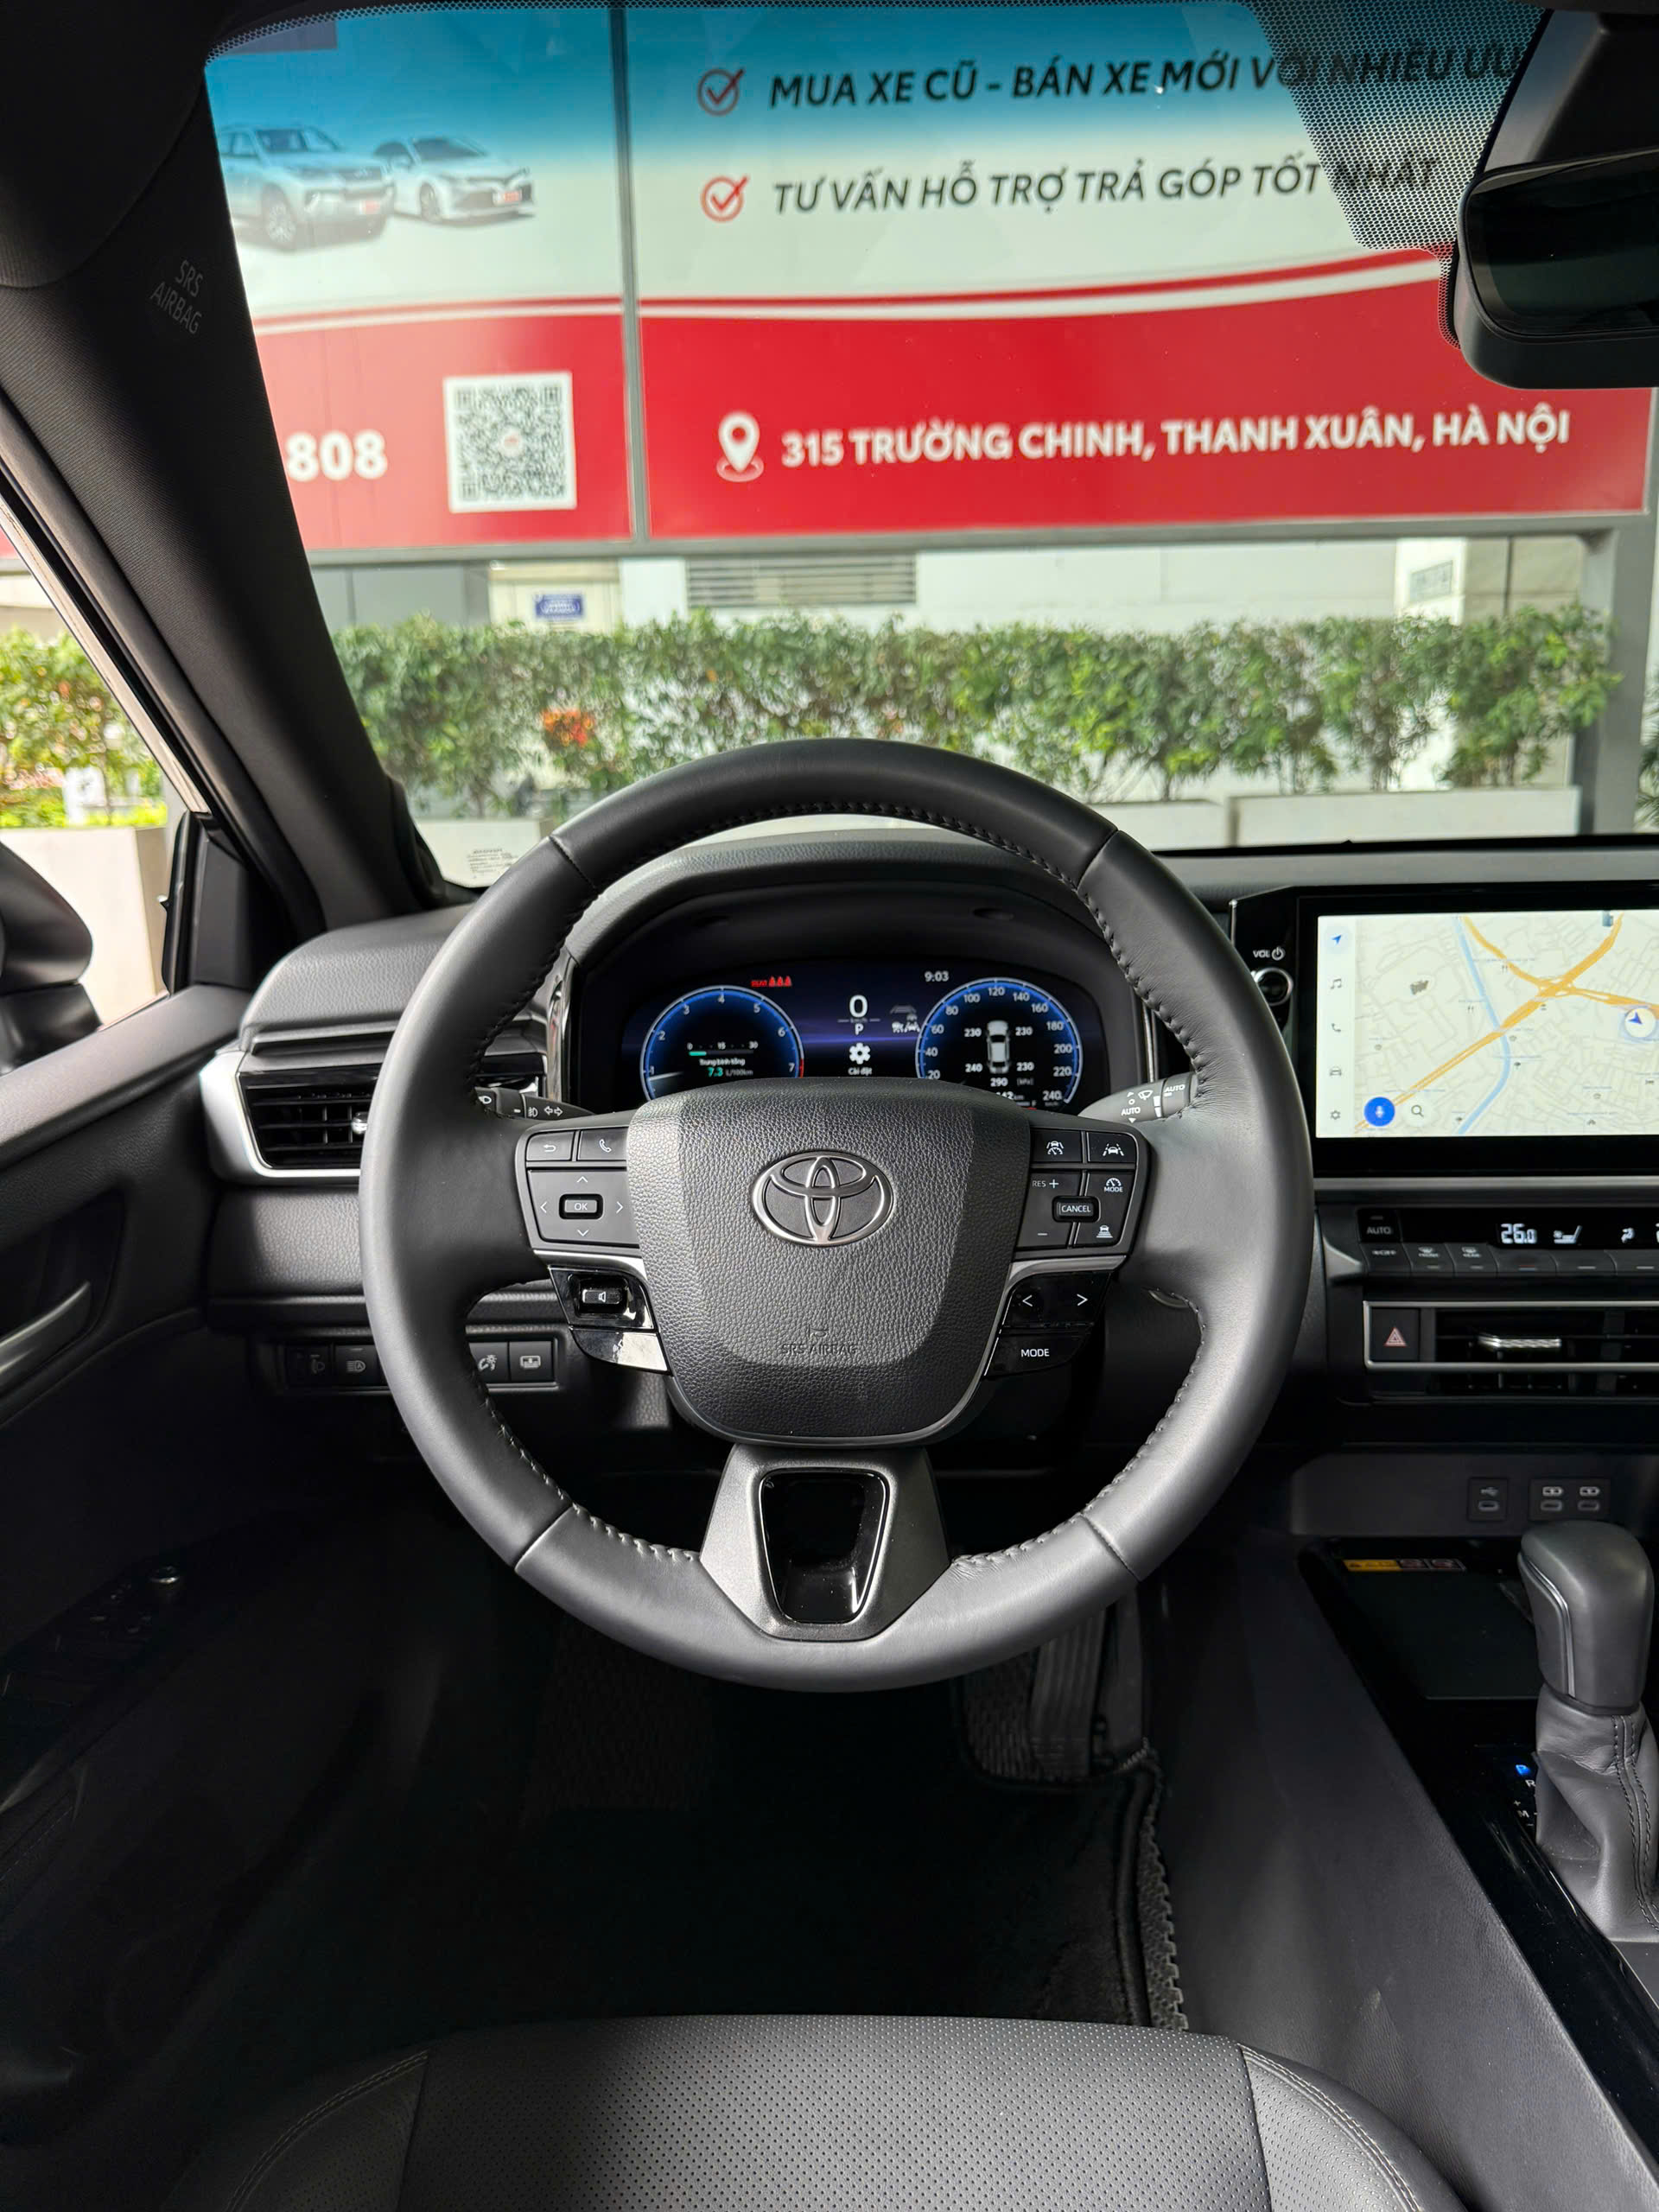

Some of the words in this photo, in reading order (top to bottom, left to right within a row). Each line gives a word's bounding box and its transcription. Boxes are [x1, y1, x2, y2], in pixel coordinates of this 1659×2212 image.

[770, 73, 856, 110] MUA
[868, 70, 916, 105] XE
[923, 59, 978, 101] CŨ
[1012, 54, 1093, 99] BÁN
[1103, 60, 1151, 96] XE
[1160, 49, 1239, 92] MỚI
[774, 176, 824, 214] TƯ
[831, 166, 909, 211] VẤN
[921, 158, 978, 208] HỖ
[989, 166, 1069, 213] TRỢ
[1077, 156, 1146, 203] TRẢ
[1156, 156, 1242, 199] GÓP
[1252, 152, 1321, 197] TỐT
[175, 259, 203, 297] SRS
[149, 281, 202, 334] AIRBAG
[781, 429, 844, 468] 315
[849, 416, 1013, 465] TRƯỜNG
[1018, 420, 1156, 462] CHINH,
[1160, 415, 1298, 456] THANH
[1304, 404, 1426, 454] XUÂN,
[1432, 403, 1490, 448] HÀ
[1497, 402, 1570, 454] NỘI
[285, 429, 388, 481] 808
[1252, 949, 1271, 958] VOL
[924, 970, 950, 982] 9:03
[988, 987, 1006, 997] 120
[1013, 991, 1031, 1002] 140
[717, 995, 726, 1005] 4
[963, 993, 982, 1003] 100
[683, 1004, 690, 1015] 3
[753, 1003, 761, 1014] 5
[945, 1005, 959, 1016] 80
[1031, 1002, 1049, 1014] 160
[855, 1022, 864, 1036] P
[931, 1024, 944, 1035] 60
[1015, 1026, 1033, 1036] 230
[1046, 1020, 1064, 1032] 180
[658, 1030, 666, 1041] 2
[778, 1026, 786, 1038] 6
[963, 1027, 982, 1038] 230
[925, 1046, 938, 1058] 40
[1053, 1044, 1072, 1054] 200
[707, 1066, 724, 1077] 7.3
[788, 1062, 796, 1073] 7
[964, 1063, 983, 1073] 240
[1016, 1061, 1035, 1072] 230
[1052, 1065, 1073, 1077] 220
[928, 1069, 941, 1080] 20
[989, 1077, 1009, 1087] 290
[1163, 1084, 1186, 1094] AUTO
[1042, 1090, 1063, 1101] 240
[1121, 1106, 1141, 1117] AUTO
[574, 1202, 588, 1211] OK
[1061, 1205, 1091, 1213] CANCEL
[1366, 1226, 1392, 1235] AUTO
[1500, 1223, 1538, 1244] 26.0
[781, 1344, 805, 1356] SRS
[809, 1344, 859, 1356] AIRBAG
[1020, 1348, 1050, 1357] MODE
[1516, 1809, 1529, 1818] M
